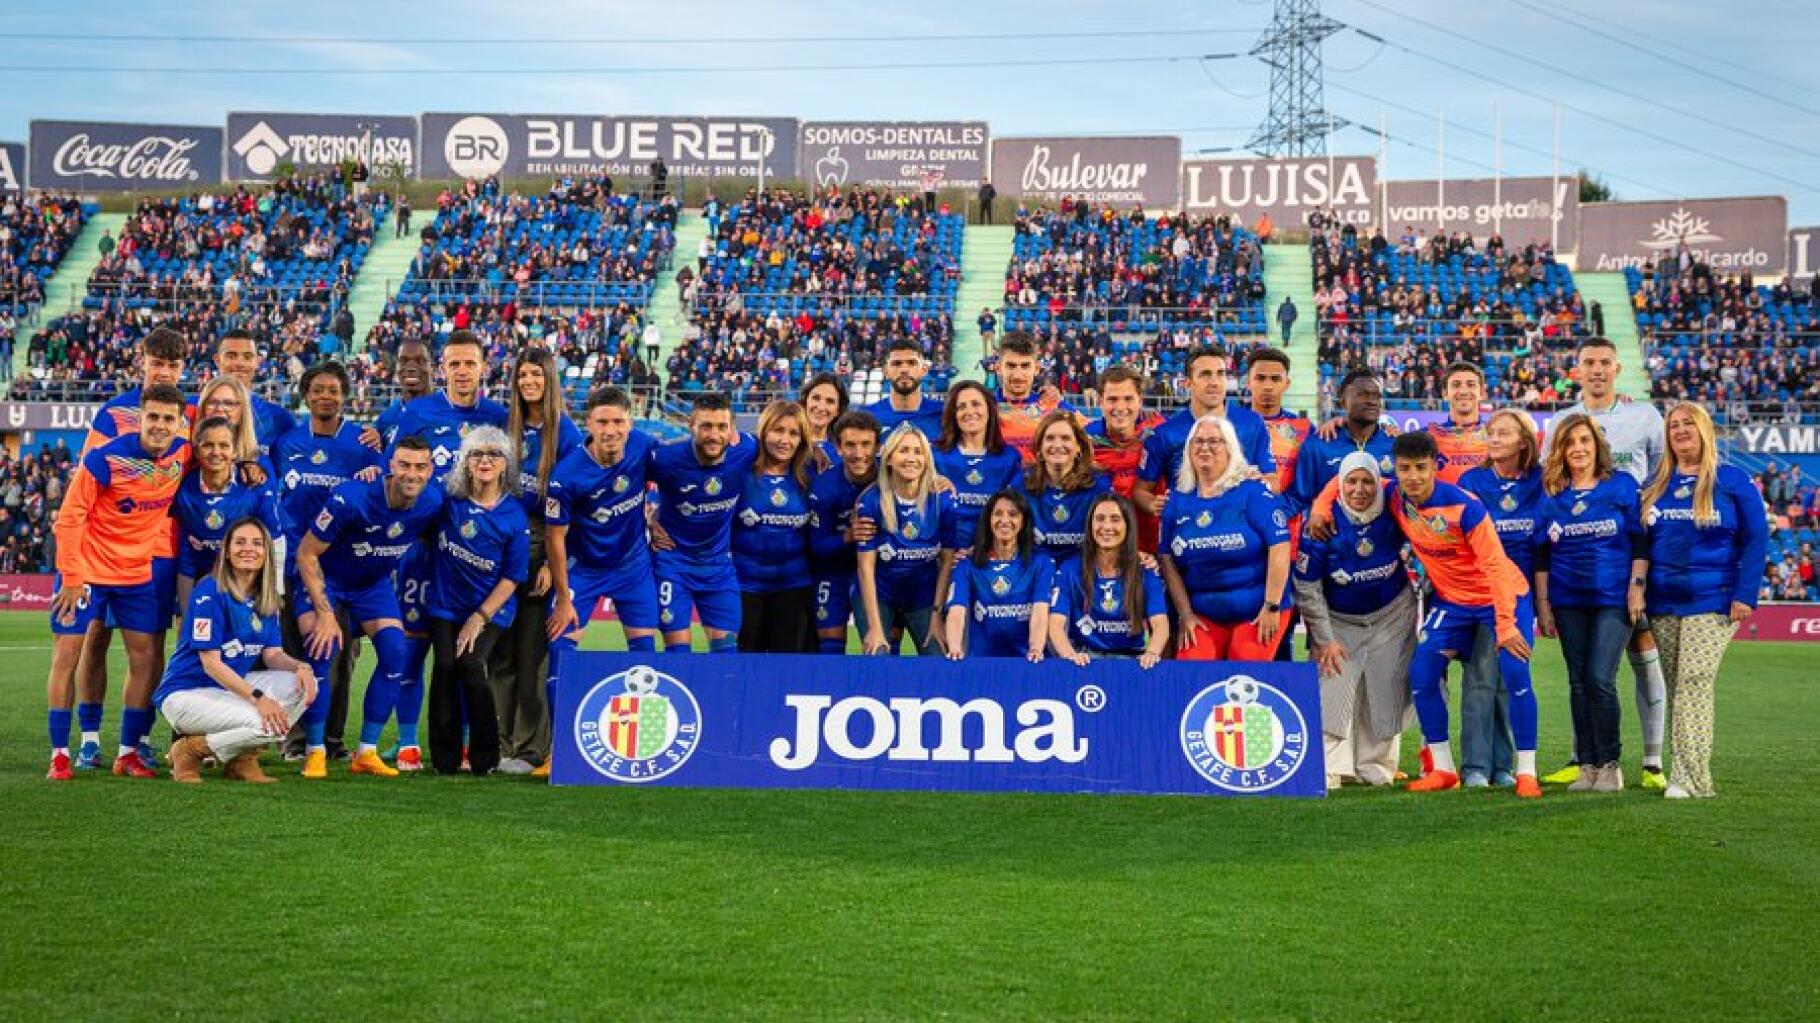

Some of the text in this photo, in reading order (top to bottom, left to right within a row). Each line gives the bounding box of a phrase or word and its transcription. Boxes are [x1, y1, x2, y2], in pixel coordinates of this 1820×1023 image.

[455, 135, 500, 160] BR
[526, 121, 776, 161] BLUE RED
[805, 127, 984, 145] SOMOS-DENTAL.ES
[865, 148, 979, 161] LIMPIEZA DENTAL
[53, 133, 199, 180] Coca-Cola
[1022, 144, 1148, 190] Bulevar
[1186, 163, 1370, 207] LUJISA
[1388, 205, 1471, 221] vamos
[659, 581, 673, 606] 9
[817, 581, 831, 604] 5
[582, 721, 623, 773] GETAFE
[631, 760, 663, 777] C.F.
[770, 694, 1089, 771] Joma
[1187, 731, 1233, 783] GETAFE
[1241, 769, 1273, 787] C.F.
